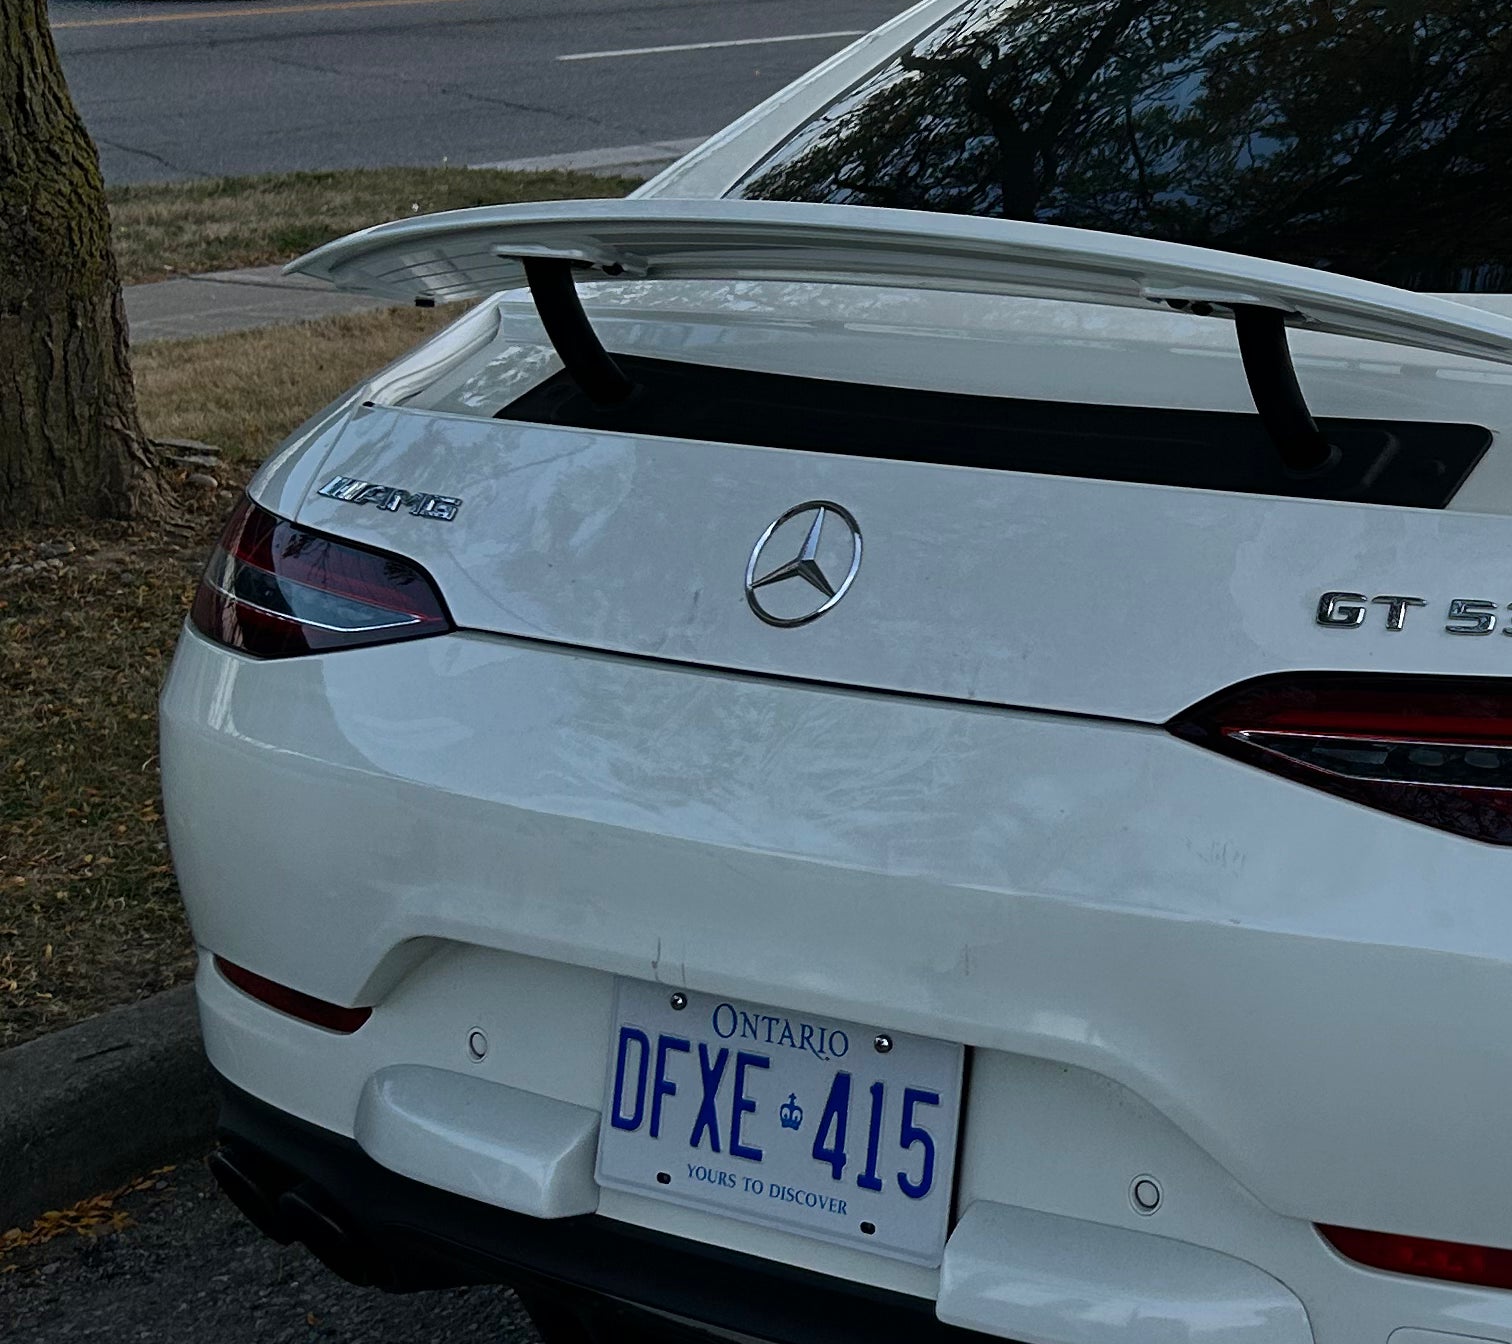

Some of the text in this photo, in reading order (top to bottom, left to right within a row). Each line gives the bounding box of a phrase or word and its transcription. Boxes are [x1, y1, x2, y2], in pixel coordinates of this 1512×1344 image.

[1316, 591, 1428, 632] GT
[610, 1025, 941, 1200] DFXE 415
[687, 1163, 848, 1216] YOURS TO DISCOVER
